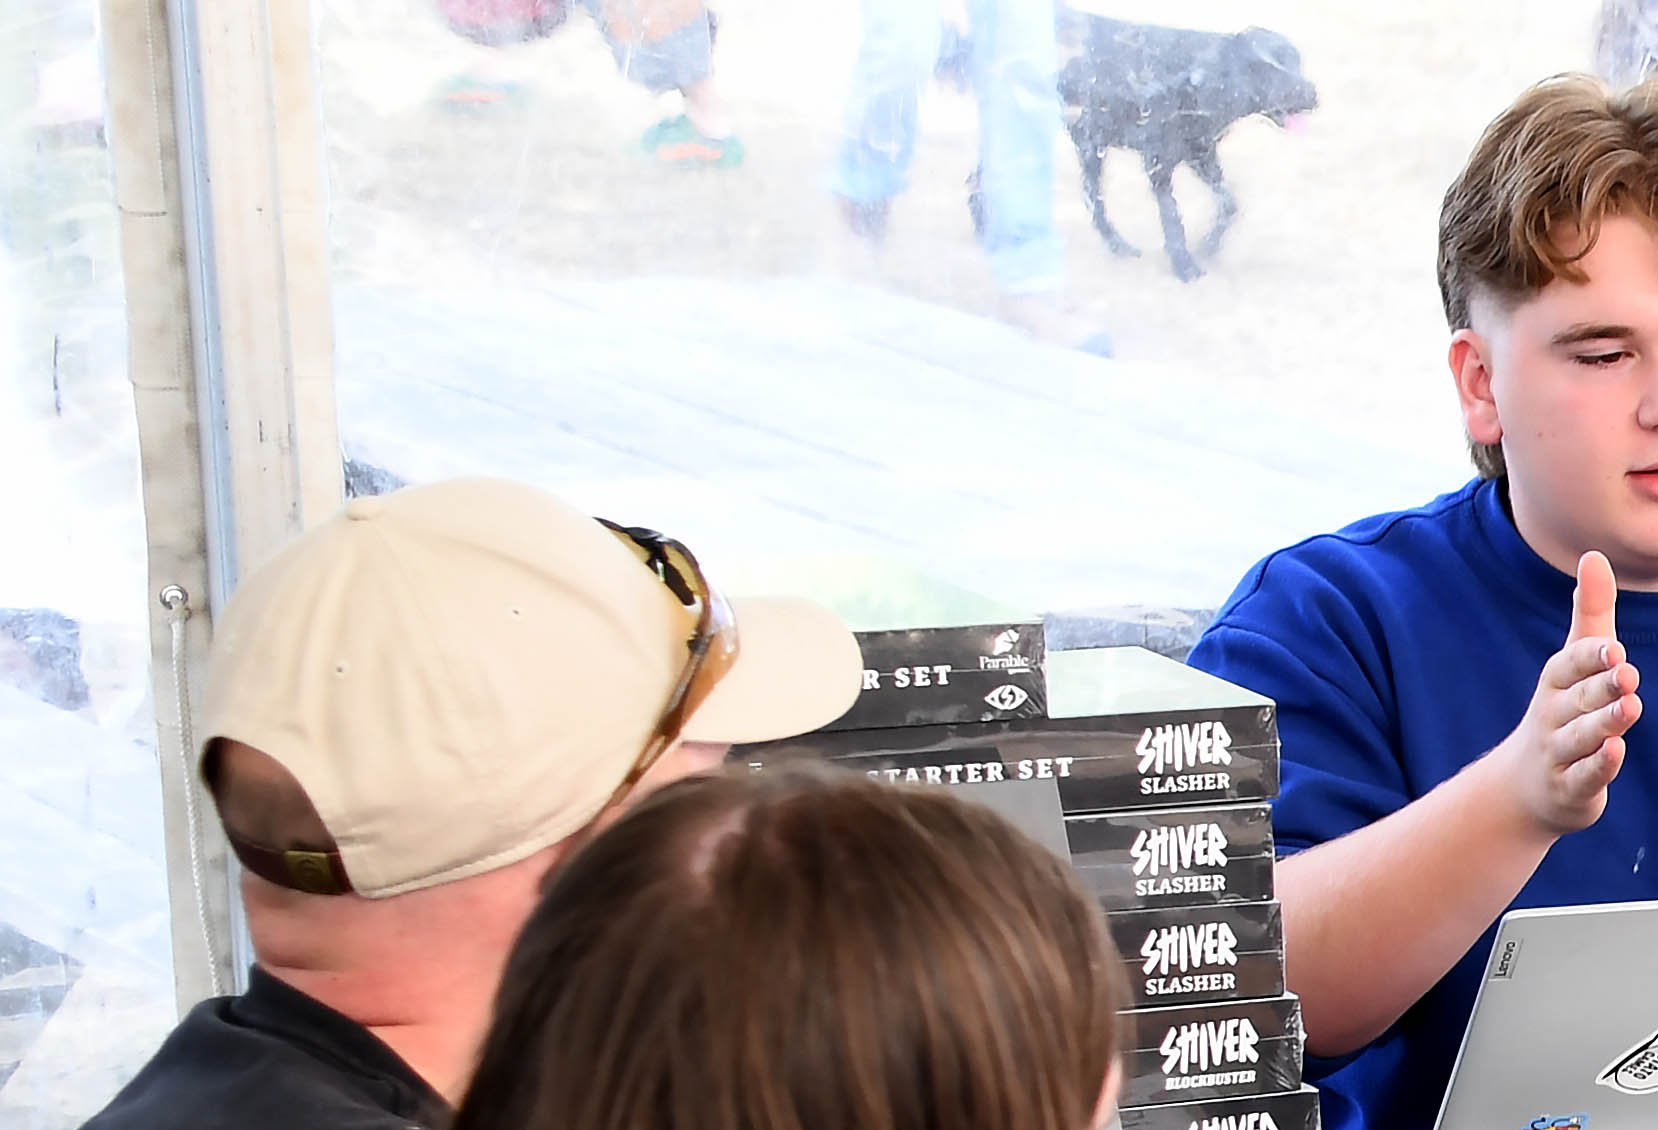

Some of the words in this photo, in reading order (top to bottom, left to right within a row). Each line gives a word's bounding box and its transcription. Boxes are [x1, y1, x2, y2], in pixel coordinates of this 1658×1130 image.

[895, 665, 951, 687] SET
[1135, 720, 1232, 774] SHIVER
[1015, 757, 1073, 779] SET
[1140, 773, 1230, 795] SLASHER
[1130, 823, 1228, 876] SHIVER
[1134, 874, 1226, 897] SLASHER
[1140, 922, 1237, 975] SHIVER
[1494, 941, 1516, 977] Lenovo
[1145, 973, 1236, 996] SLASHER
[1159, 1018, 1259, 1075] SHIVER
[1164, 1070, 1257, 1091] BLOCKBUSTER
